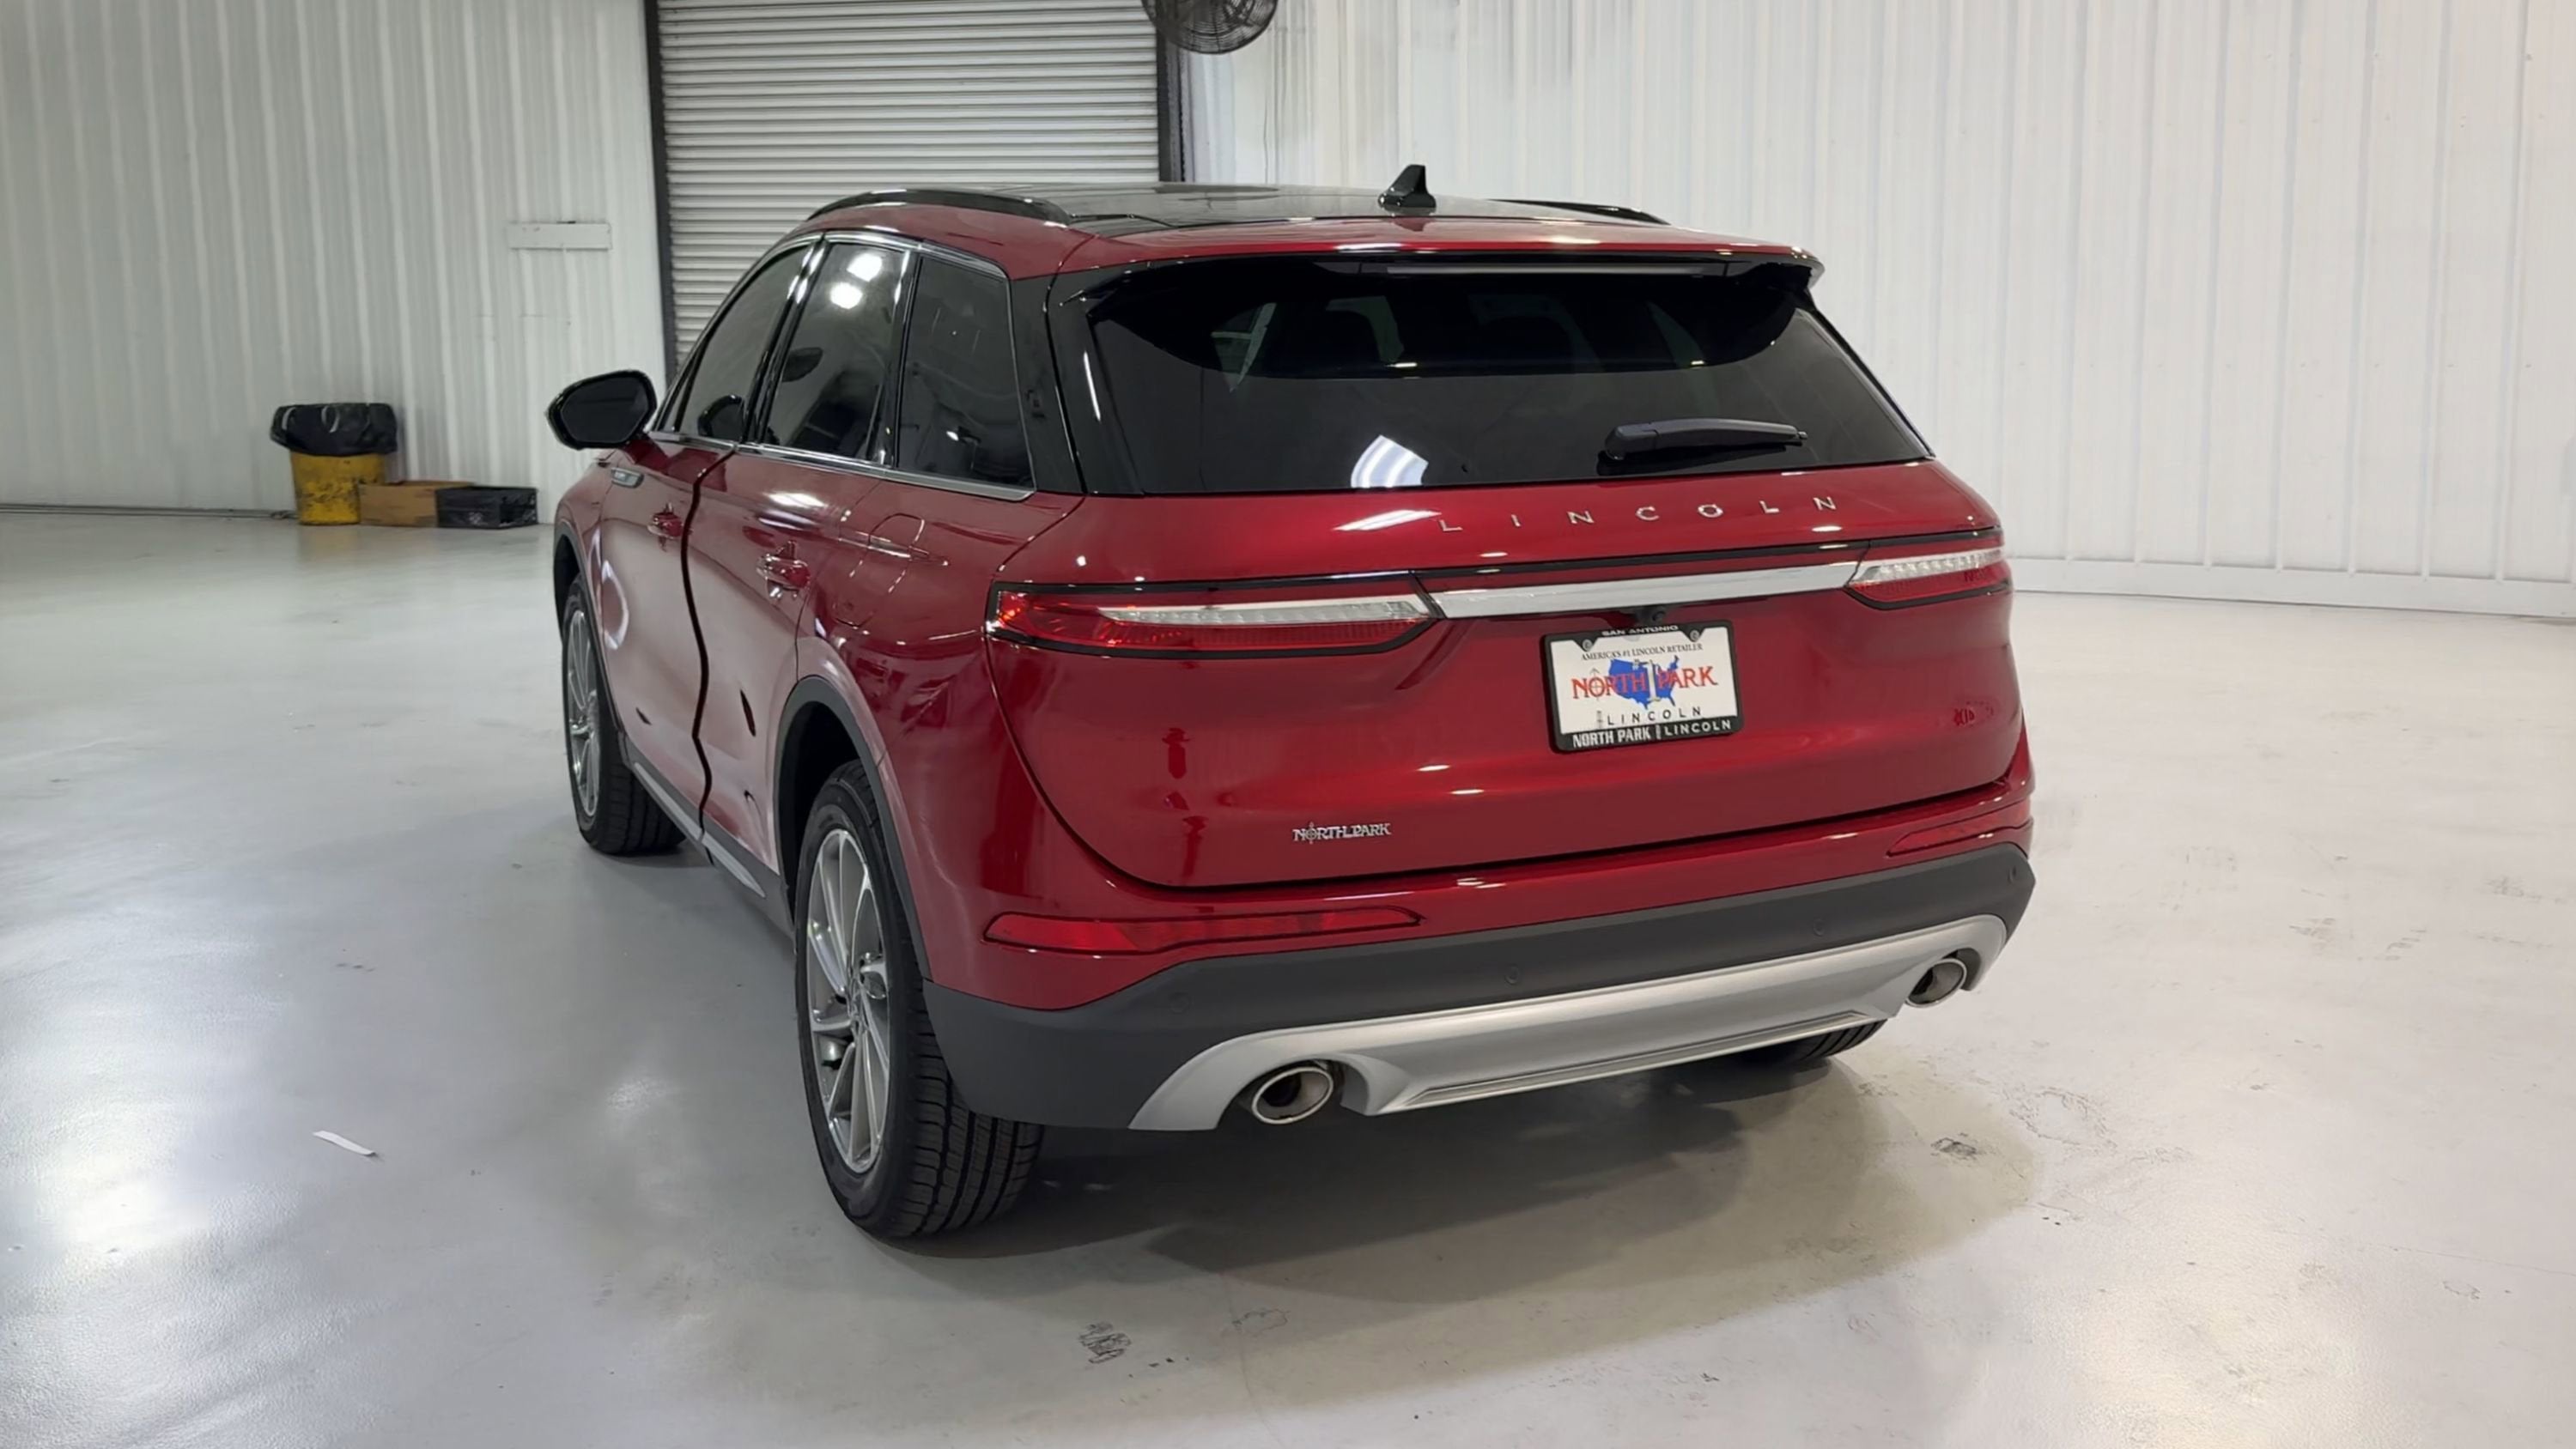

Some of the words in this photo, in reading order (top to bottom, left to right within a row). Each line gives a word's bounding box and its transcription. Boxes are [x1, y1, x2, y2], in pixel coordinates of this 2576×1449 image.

[1439, 496, 1837, 532] LINCOLN
[1629, 625, 1679, 634] ANTONIO
[1631, 646, 1665, 656] LINCOLN
[1667, 643, 1703, 653] RETAILER
[1571, 672, 1648, 700] NORTH
[1657, 666, 1718, 689] PARK
[1607, 706, 1702, 725] LINCOLN
[1572, 730, 1614, 749] NORTH
[1617, 726, 1651, 743] PARK
[1664, 719, 1731, 737] LINCOLN
